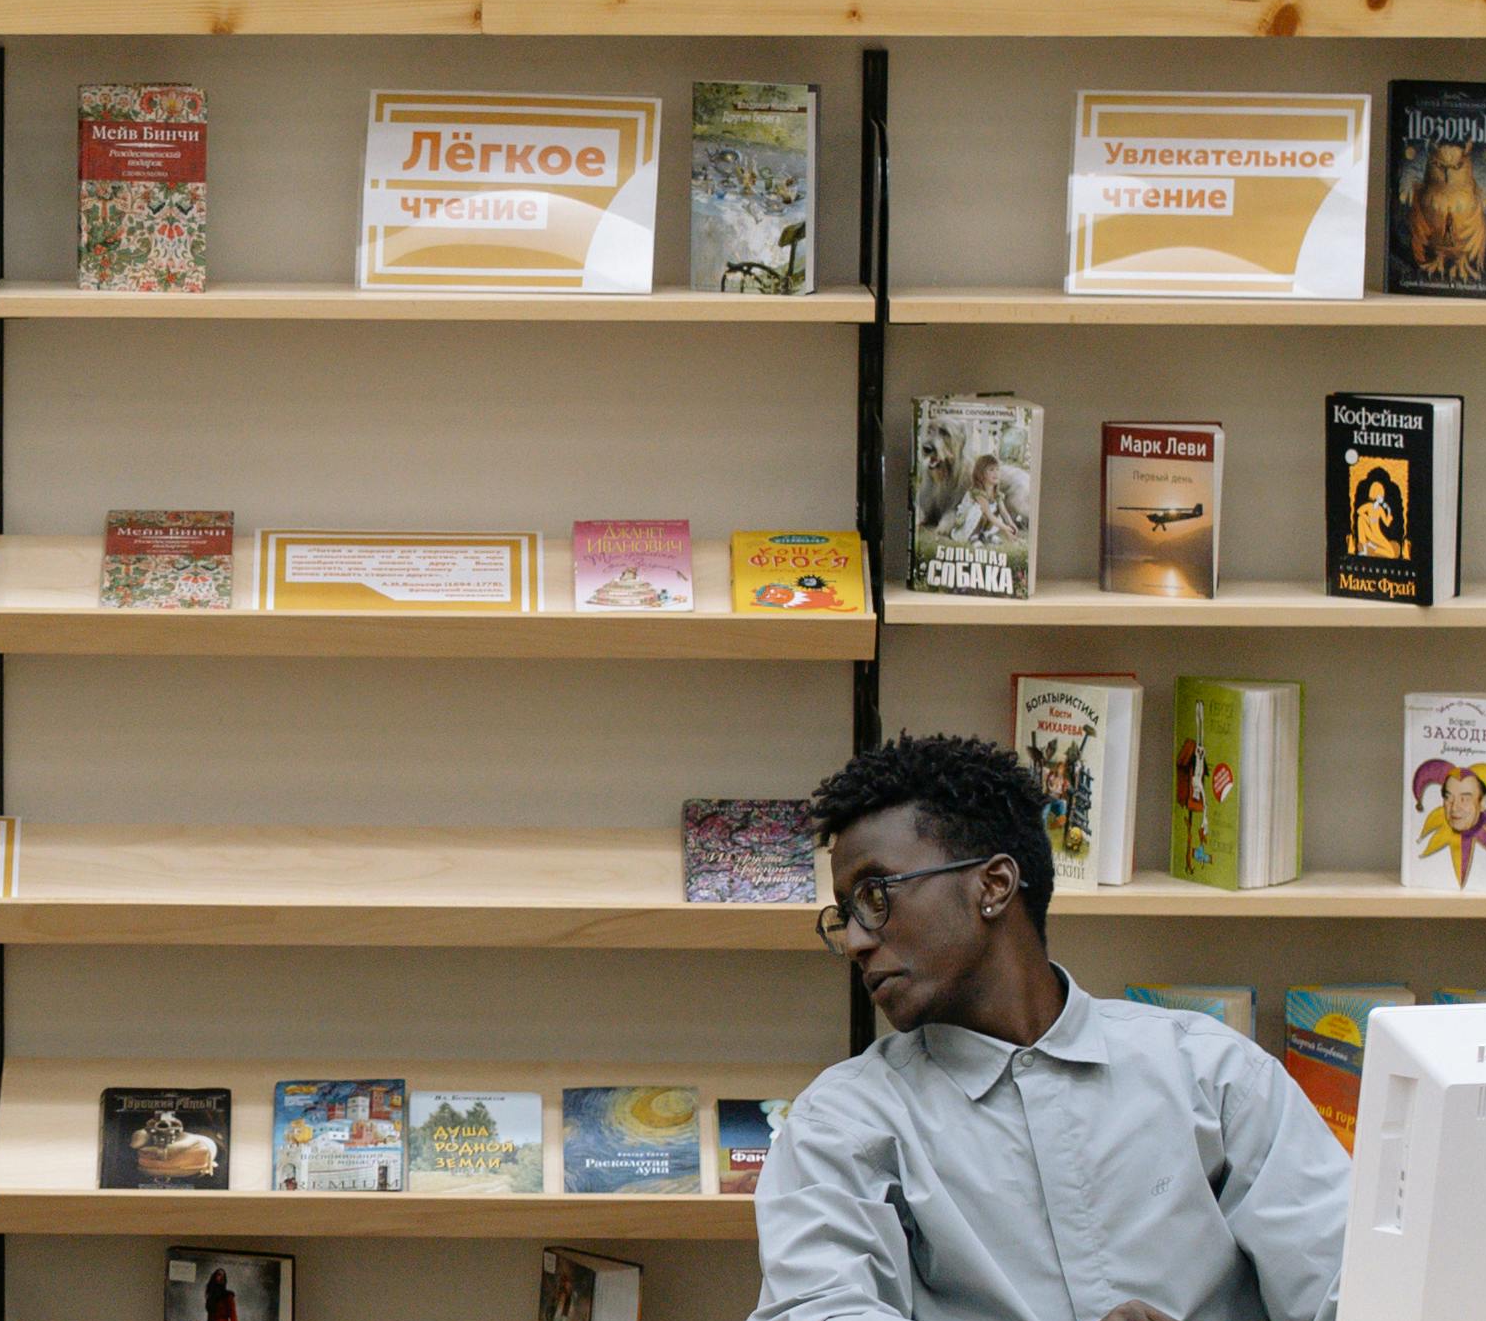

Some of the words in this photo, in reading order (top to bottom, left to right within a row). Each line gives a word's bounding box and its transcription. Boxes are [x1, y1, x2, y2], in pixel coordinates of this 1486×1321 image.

[92, 125, 135, 141] Мейв
[143, 125, 200, 143] Бинчи
[402, 130, 606, 176] Лёгкое
[1104, 142, 1335, 170] Увлекательное
[1102, 184, 1227, 209] чтение
[400, 193, 539, 223] чтение
[1333, 406, 1423, 430] Кофейная
[1120, 434, 1160, 455] Марк
[1165, 438, 1207, 457] Леви
[1353, 430, 1404, 449] книга
[603, 526, 665, 538] ДЖАНЕТ
[587, 539, 683, 554] ИВАНОВИЧ
[936, 545, 1008, 565] БОЛЬШАЯ
[748, 555, 849, 569] ФРОСЯ
[928, 560, 1013, 594] СОБАКА
[1339, 575, 1375, 592] Макс
[1377, 576, 1416, 597] Фрай
[1026, 691, 1100, 725] БОГАТЫРИСТИКА
[1037, 720, 1083, 736] ЖИХАРЕВА
[433, 1125, 487, 1138] ДУША
[435, 1139, 513, 1154] РОДНОЙ
[435, 1155, 501, 1169] ЗЕМЛИ
[585, 1157, 669, 1169] Расколотая
